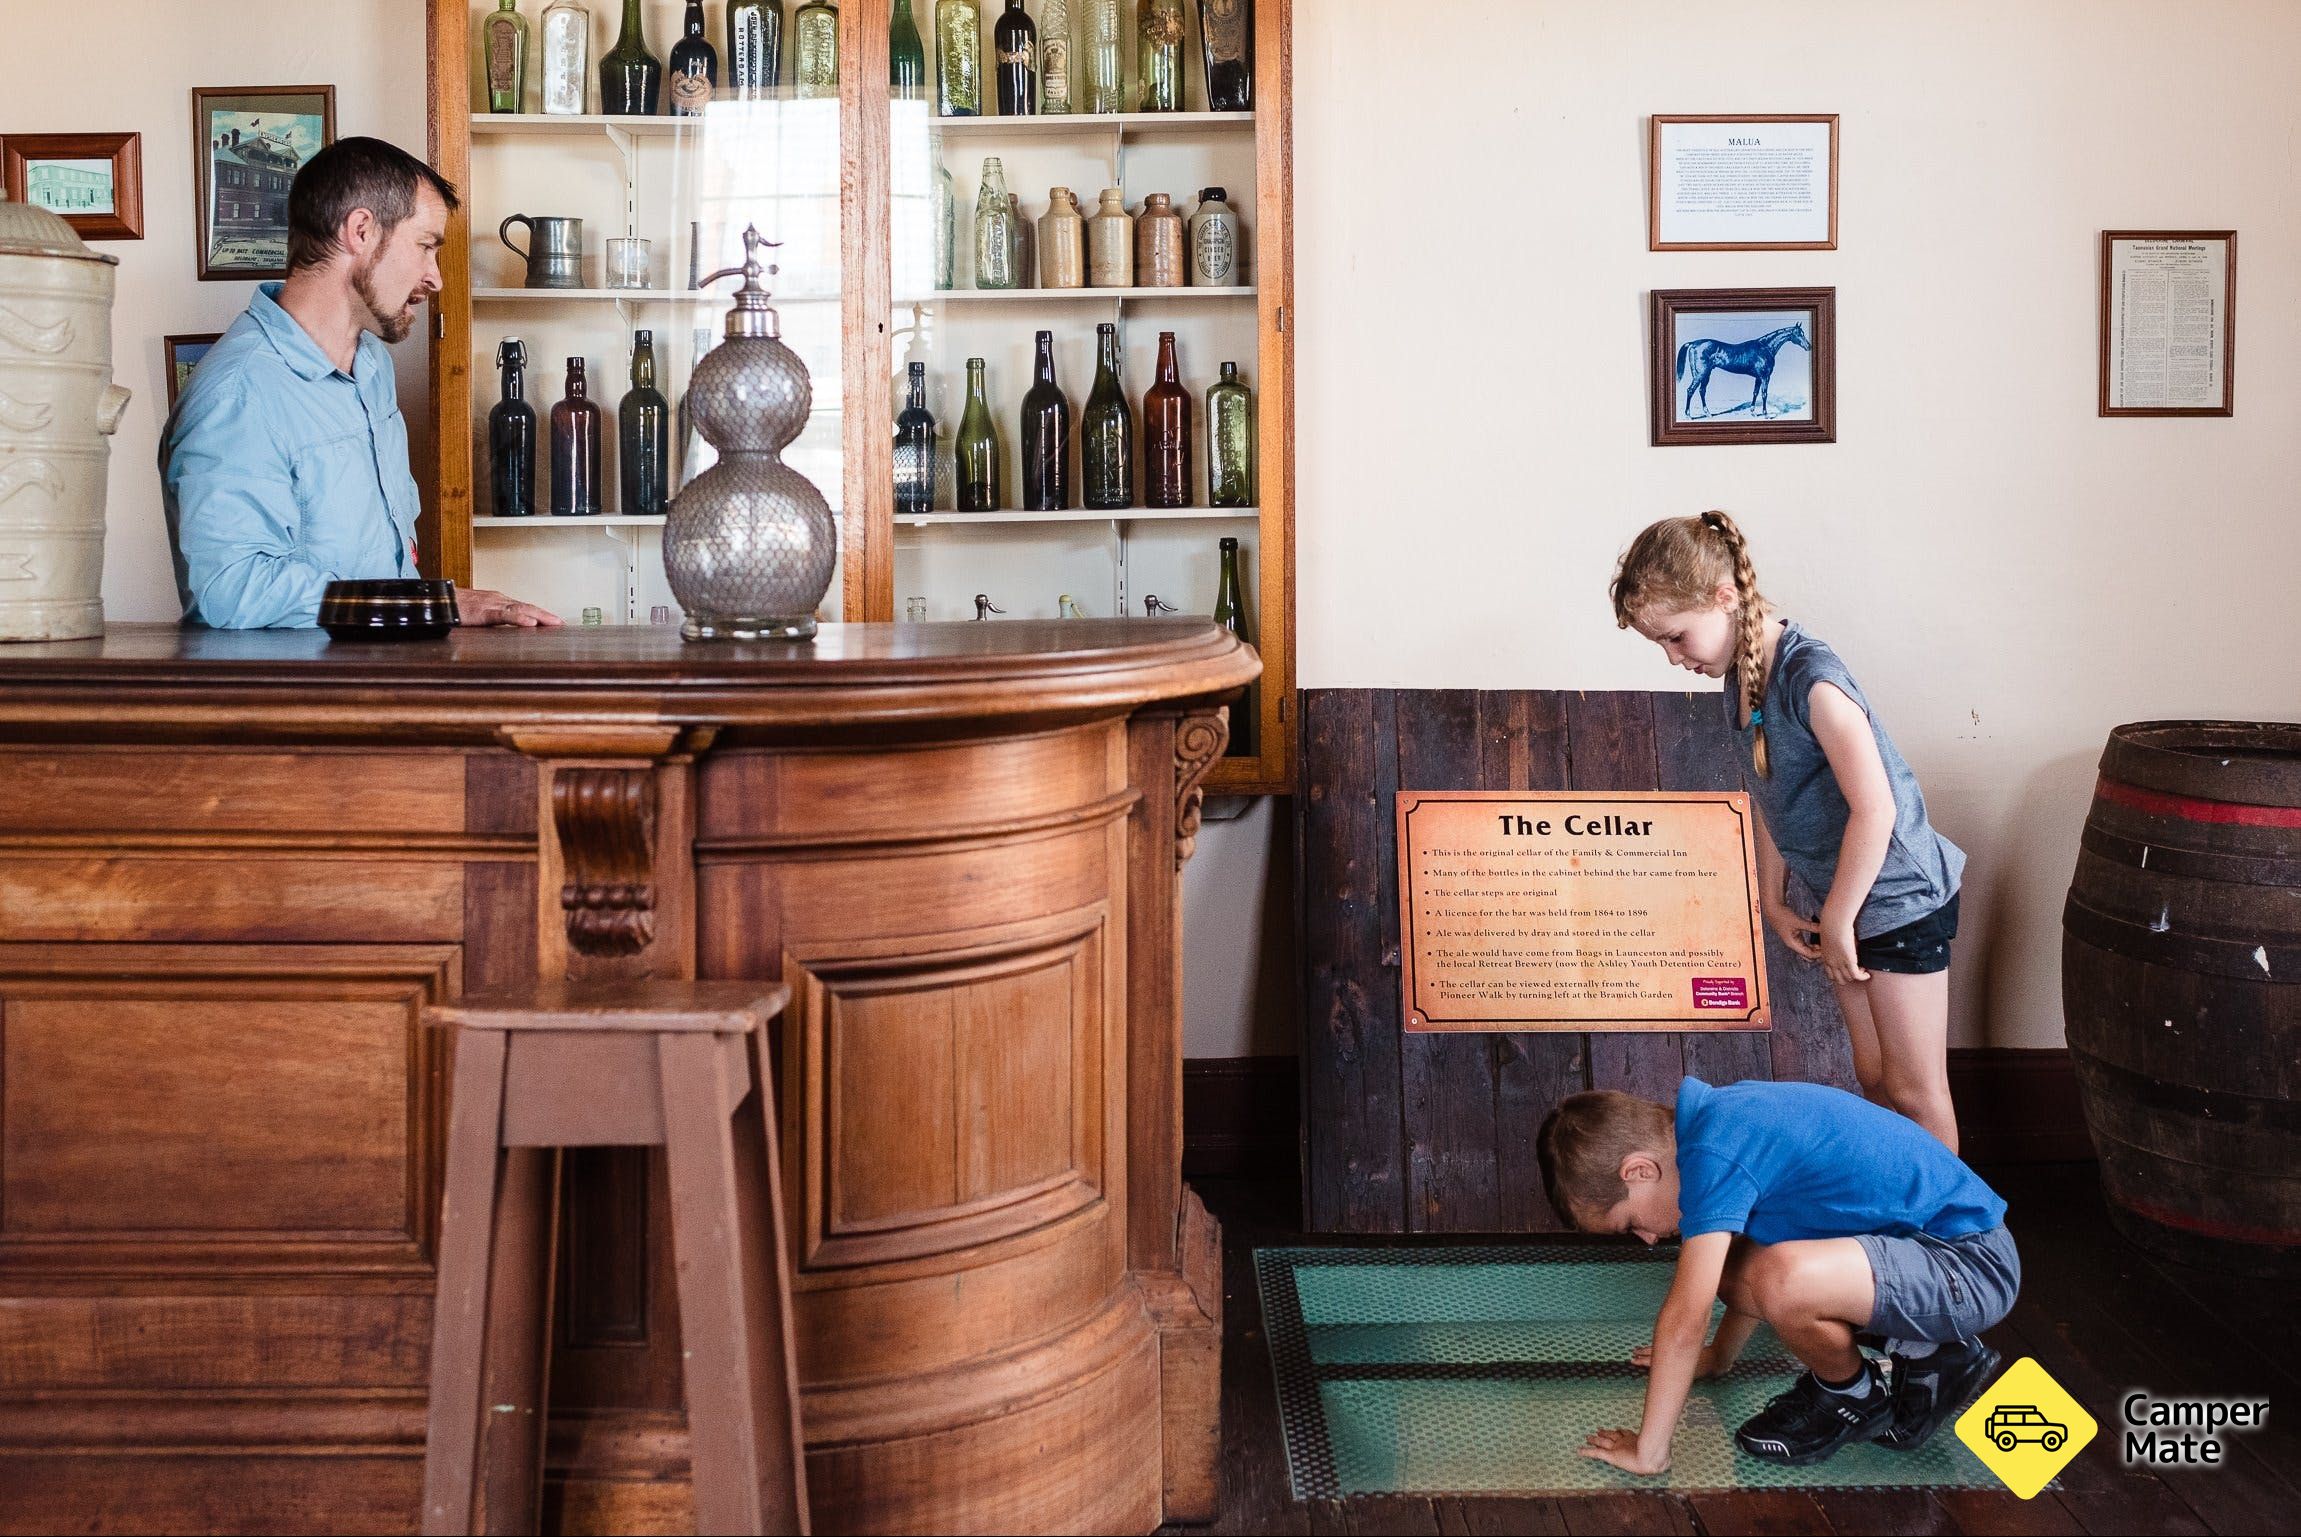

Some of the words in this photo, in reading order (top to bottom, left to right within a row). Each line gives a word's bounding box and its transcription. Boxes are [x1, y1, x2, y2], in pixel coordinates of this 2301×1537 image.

[1728, 138, 1761, 146] MALUA
[252, 248, 285, 256] COMMERCIAL
[1498, 815, 1552, 836] The
[1564, 815, 1653, 836] Cellar
[1431, 848, 1452, 857] This
[1453, 848, 1461, 857] is
[1463, 848, 1478, 857] the
[1479, 848, 1514, 859] original
[1516, 848, 1542, 857] cellar
[1543, 848, 1554, 857] of
[1555, 848, 1569, 857] the
[1571, 848, 1603, 859] Family
[1604, 848, 1615, 857] &
[1616, 848, 1670, 857] Commercial
[1672, 848, 1688, 857] Inn
[1432, 868, 1458, 879] Many
[1460, 868, 1470, 877] of
[1472, 868, 1487, 877] the
[1488, 868, 1519, 877] bottles
[1521, 868, 1530, 877] in
[1532, 868, 1547, 877] the
[1548, 868, 1581, 877] cabinet
[1583, 868, 1614, 877] behind
[1615, 868, 1631, 877] the
[1633, 868, 1648, 877] bar
[1674, 868, 1696, 877] from
[1698, 868, 1718, 877] here
[1433, 888, 1452, 897] The
[1453, 888, 1479, 897] cellar
[1481, 888, 1505, 899] steps
[1522, 888, 1557, 899] original
[1434, 908, 1443, 917] A
[1444, 908, 1478, 917] licence
[1479, 908, 1493, 917] for
[1495, 908, 1510, 917] the
[1511, 908, 1527, 917] bar
[1548, 908, 1568, 917] held
[1569, 908, 1591, 917] from
[1594, 908, 1614, 917] 1864
[1628, 908, 1648, 917] 1896
[1435, 929, 1452, 937] Ale
[1473, 929, 1516, 937] delivered
[1518, 929, 1529, 939] by
[1531, 929, 1552, 939] dray
[1553, 929, 1570, 937] and
[1572, 929, 1600, 937] stored
[1602, 929, 1611, 937] in
[1613, 929, 1629, 937] the
[1630, 929, 1656, 937] cellar
[1436, 949, 1454, 957] The
[1456, 949, 1470, 957] ale
[1472, 949, 1500, 957] would
[1502, 949, 1523, 957] have
[1551, 949, 1574, 957] from
[1575, 949, 1602, 959] Boags
[1604, 949, 1613, 957] in
[1616, 949, 1668, 957] Launceston
[1669, 949, 1686, 957] and
[1688, 949, 1724, 959] possibly
[1436, 960, 1452, 968] the
[1453, 960, 1476, 968] local
[1478, 960, 1512, 968] Retreat
[1515, 960, 1553, 969] Brewery
[1555, 960, 1577, 969] (now
[1580, 960, 1595, 968] the
[1597, 960, 1628, 969] Ashley
[1630, 960, 1658, 968] Youth
[1659, 960, 1705, 968] Detention
[1707, 960, 1742, 969] Centre)
[1439, 979, 1458, 988] The
[1459, 979, 1486, 988] cellar
[1505, 979, 1518, 988] be
[1519, 979, 1552, 988] viewed
[1553, 979, 1600, 990] externally
[1601, 979, 1623, 988] from
[1625, 979, 1640, 988] the
[1440, 990, 1476, 1000] Pioneer
[1477, 990, 1504, 1000] Walk
[1505, 990, 1517, 1001] by
[1518, 990, 1552, 1001] turning
[1554, 990, 1570, 1000] left
[1572, 992, 1581, 1000] at
[1583, 990, 1599, 1000] the
[1600, 990, 1638, 1000] Bramich
[1640, 990, 1674, 1000] Garden
